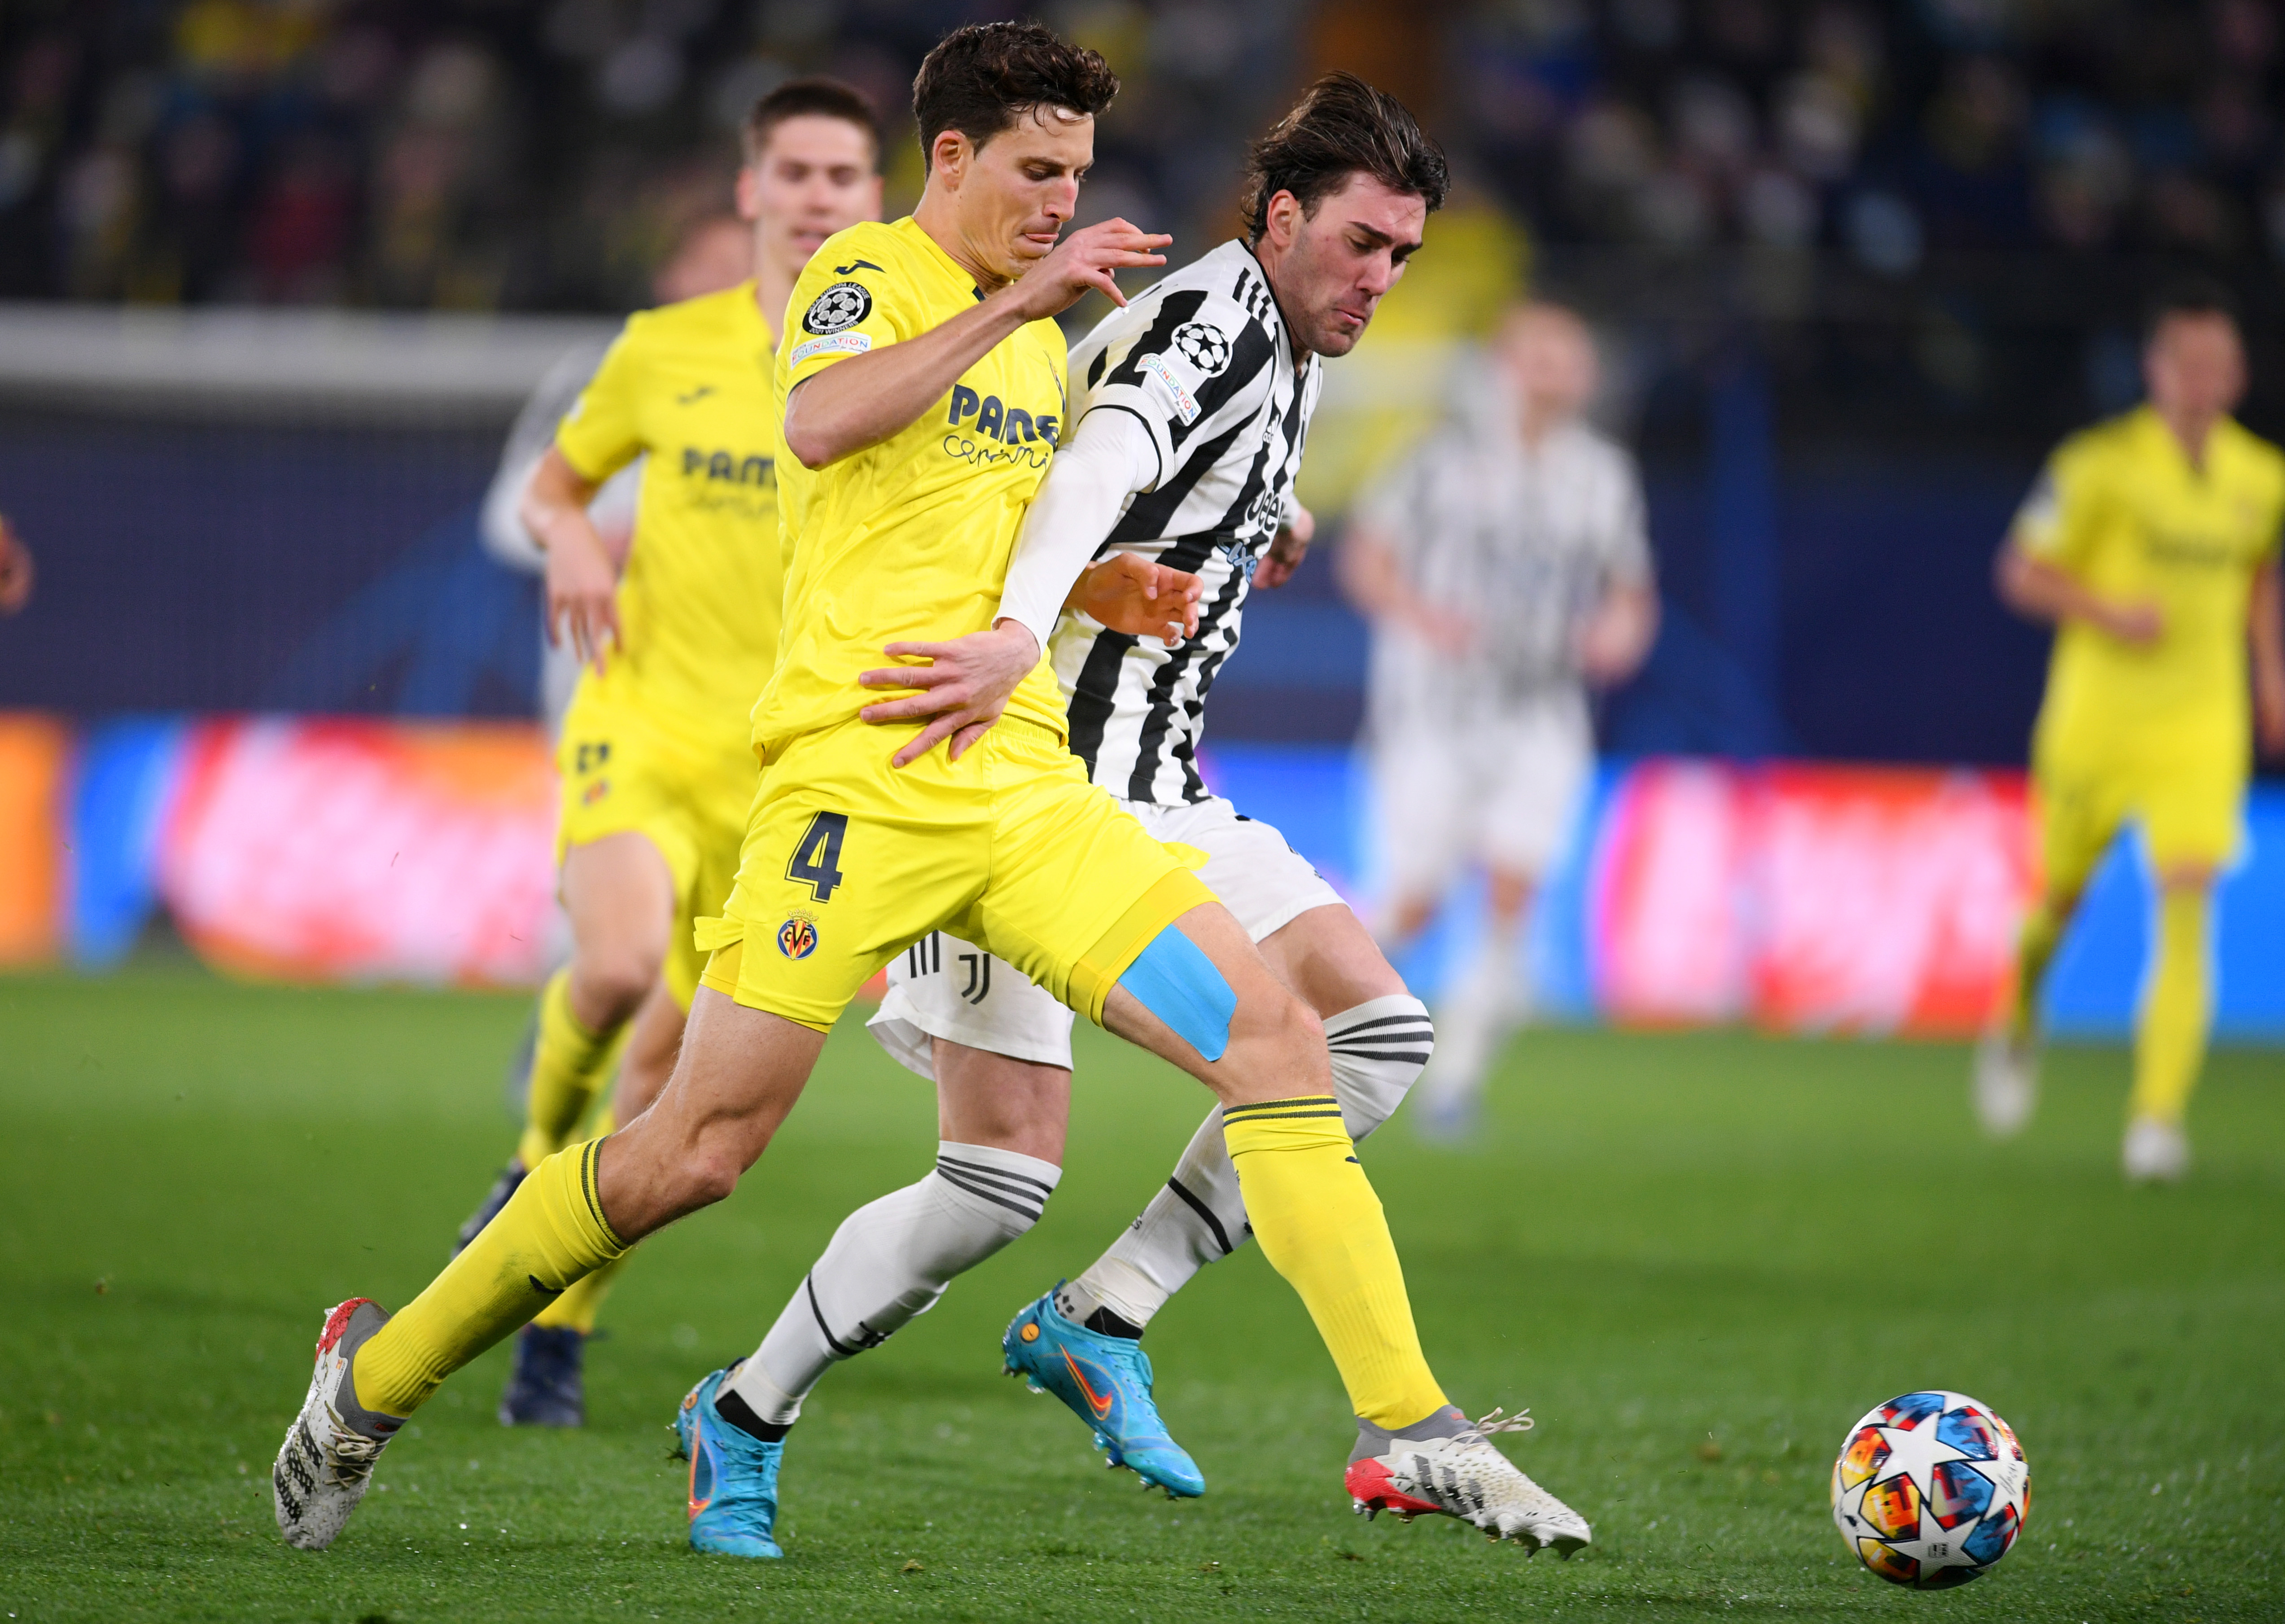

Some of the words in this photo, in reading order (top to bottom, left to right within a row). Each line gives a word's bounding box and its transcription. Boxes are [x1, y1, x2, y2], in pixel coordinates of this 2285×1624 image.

[820, 283, 847, 299] EUROPA
[848, 282, 871, 300] LEAGUE
[825, 320, 859, 334] WINNERS
[792, 337, 868, 363] FOUNDATION
[1140, 359, 1196, 418] FOUNDATION
[1247, 486, 1286, 532] Jee
[784, 810, 849, 904] 4
